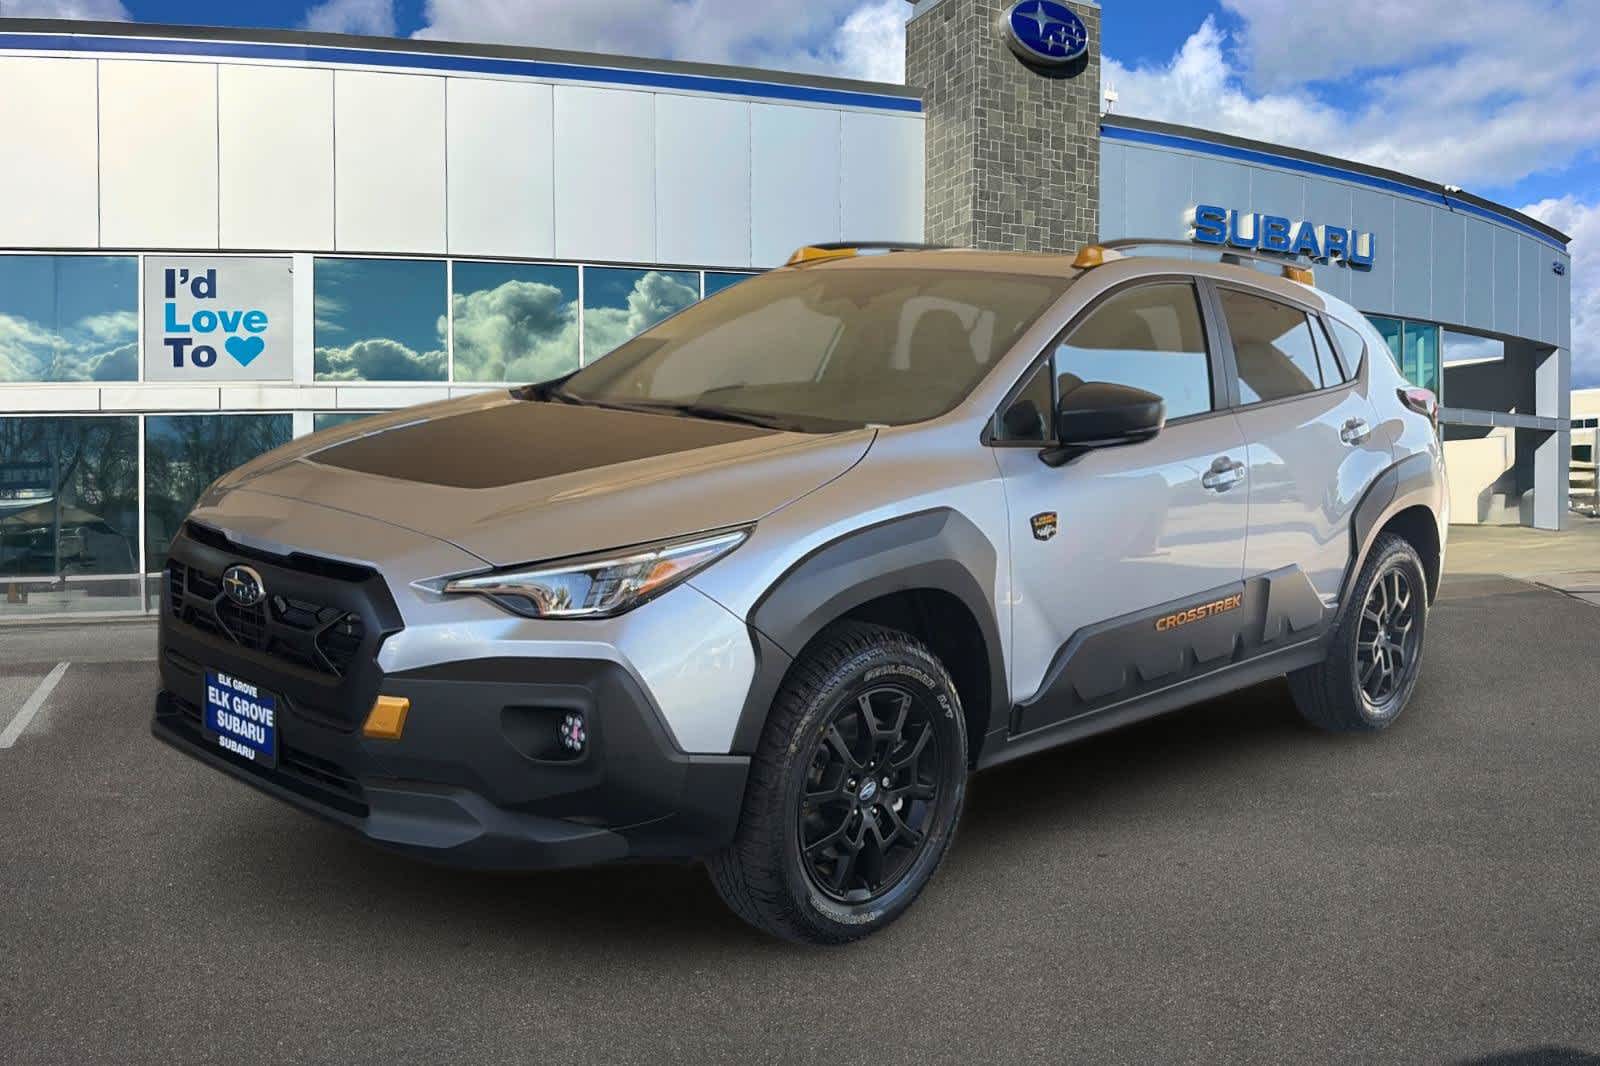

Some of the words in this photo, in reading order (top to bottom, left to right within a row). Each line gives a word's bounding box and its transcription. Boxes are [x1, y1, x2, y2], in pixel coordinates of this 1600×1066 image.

[1192, 204, 1376, 266] SUBARU
[165, 268, 217, 299] I’d
[165, 302, 269, 334] Love
[163, 337, 218, 368] To
[1156, 594, 1242, 632] CROSSTREK
[217, 673, 232, 688] ELK
[232, 679, 258, 698] GROVE
[208, 685, 230, 711] ELK
[232, 696, 274, 727] GROVE
[217, 709, 266, 744] SUBARU
[219, 735, 256, 760] SUBARU
